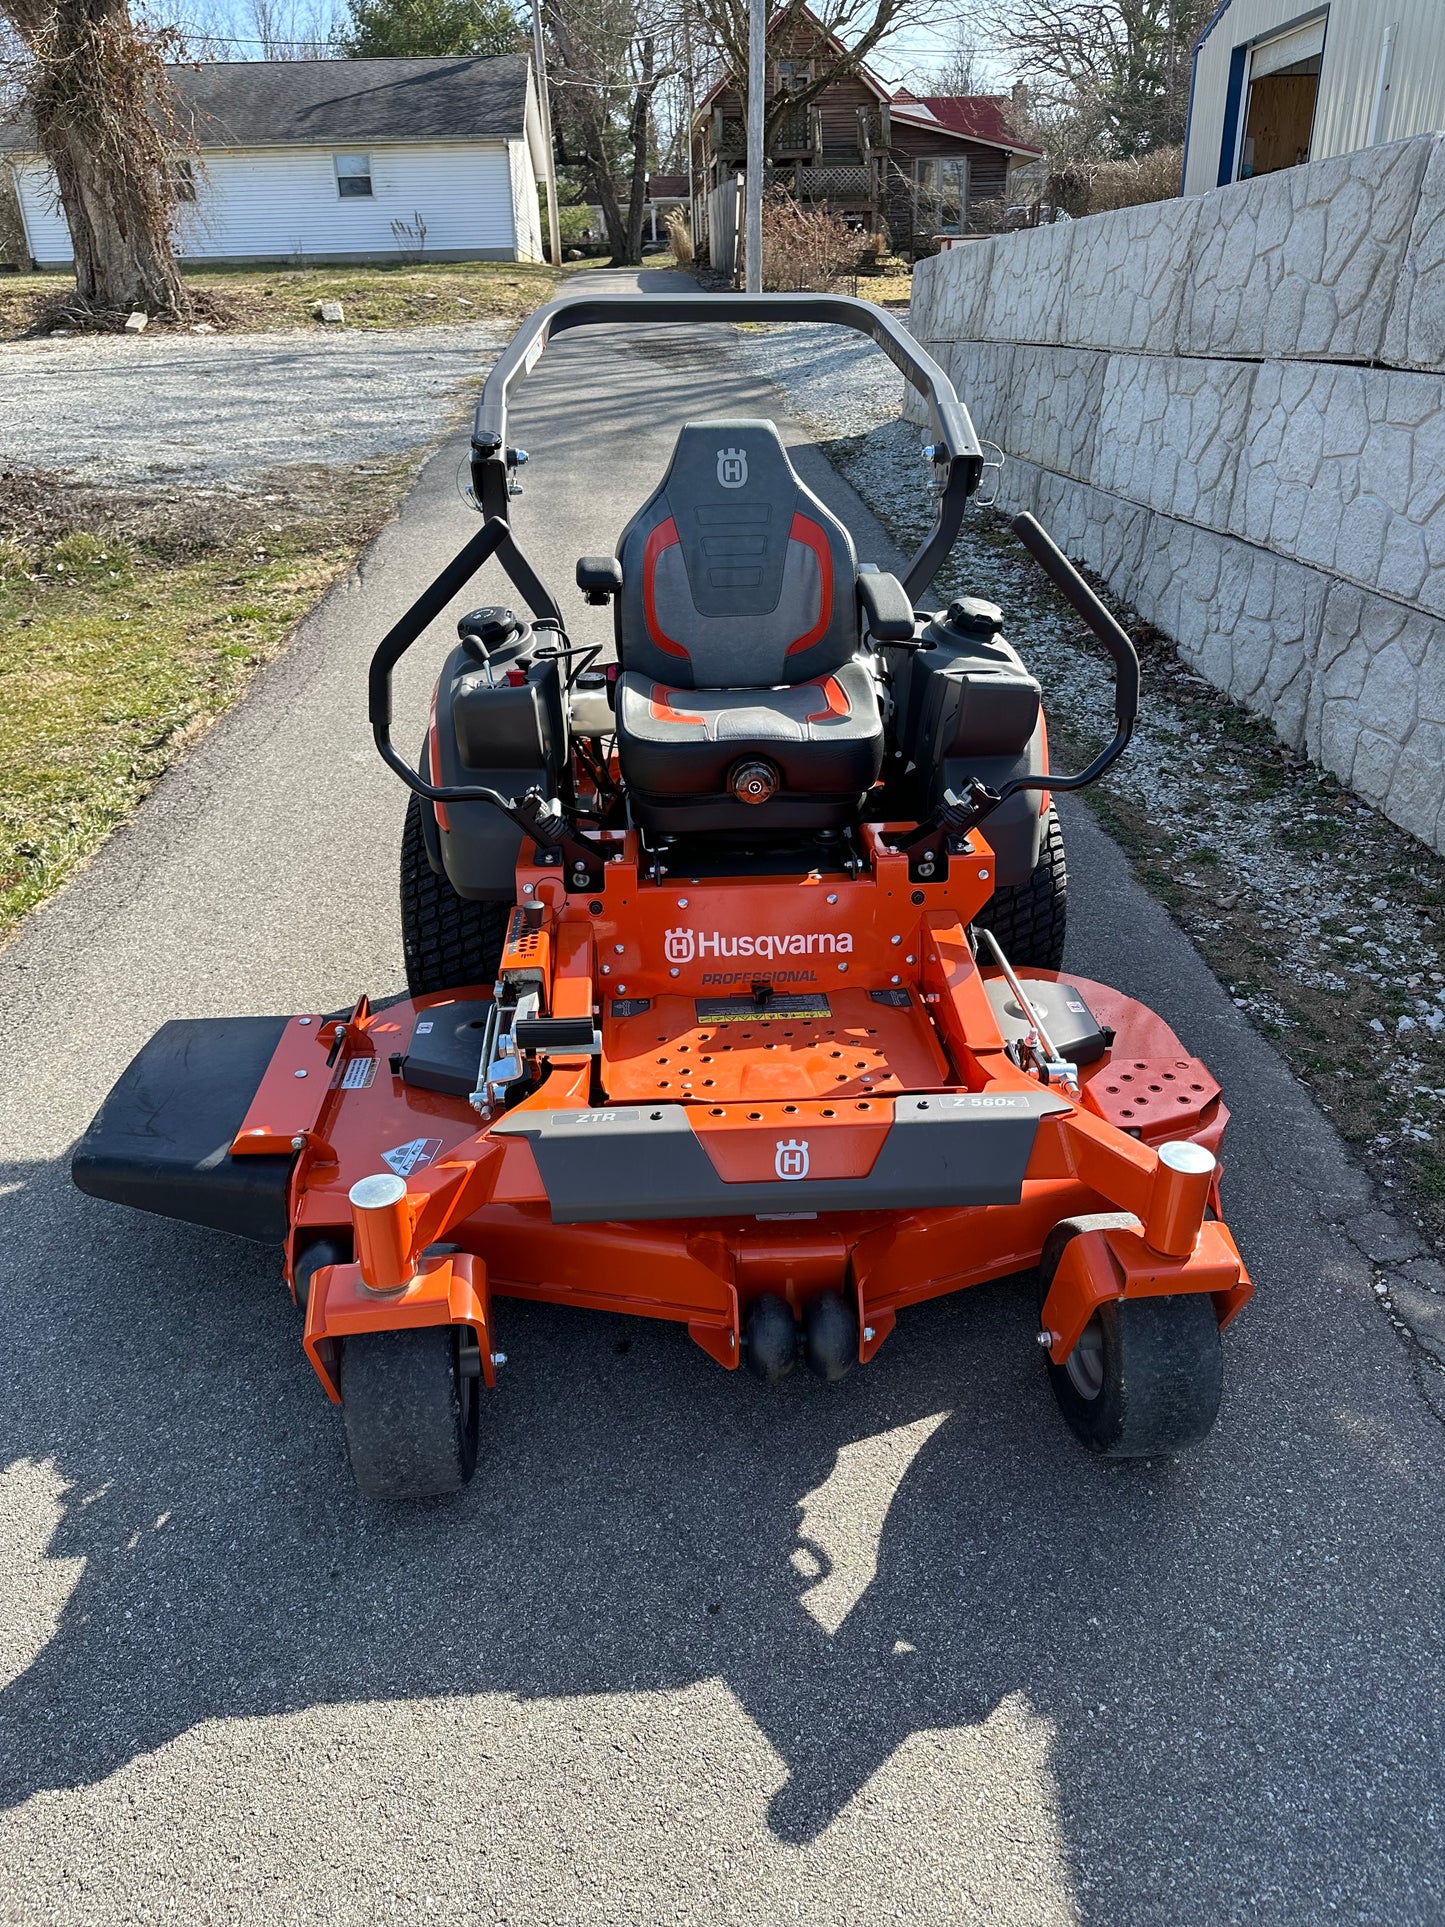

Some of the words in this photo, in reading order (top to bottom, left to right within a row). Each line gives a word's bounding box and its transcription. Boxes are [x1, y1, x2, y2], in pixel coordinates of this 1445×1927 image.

[698, 931, 853, 960] Husqvarna
[701, 970, 818, 985] PROFESSIONAL
[953, 1098, 965, 1107] Z
[971, 1098, 1016, 1107] 560x
[575, 1112, 617, 1124] ZTR
